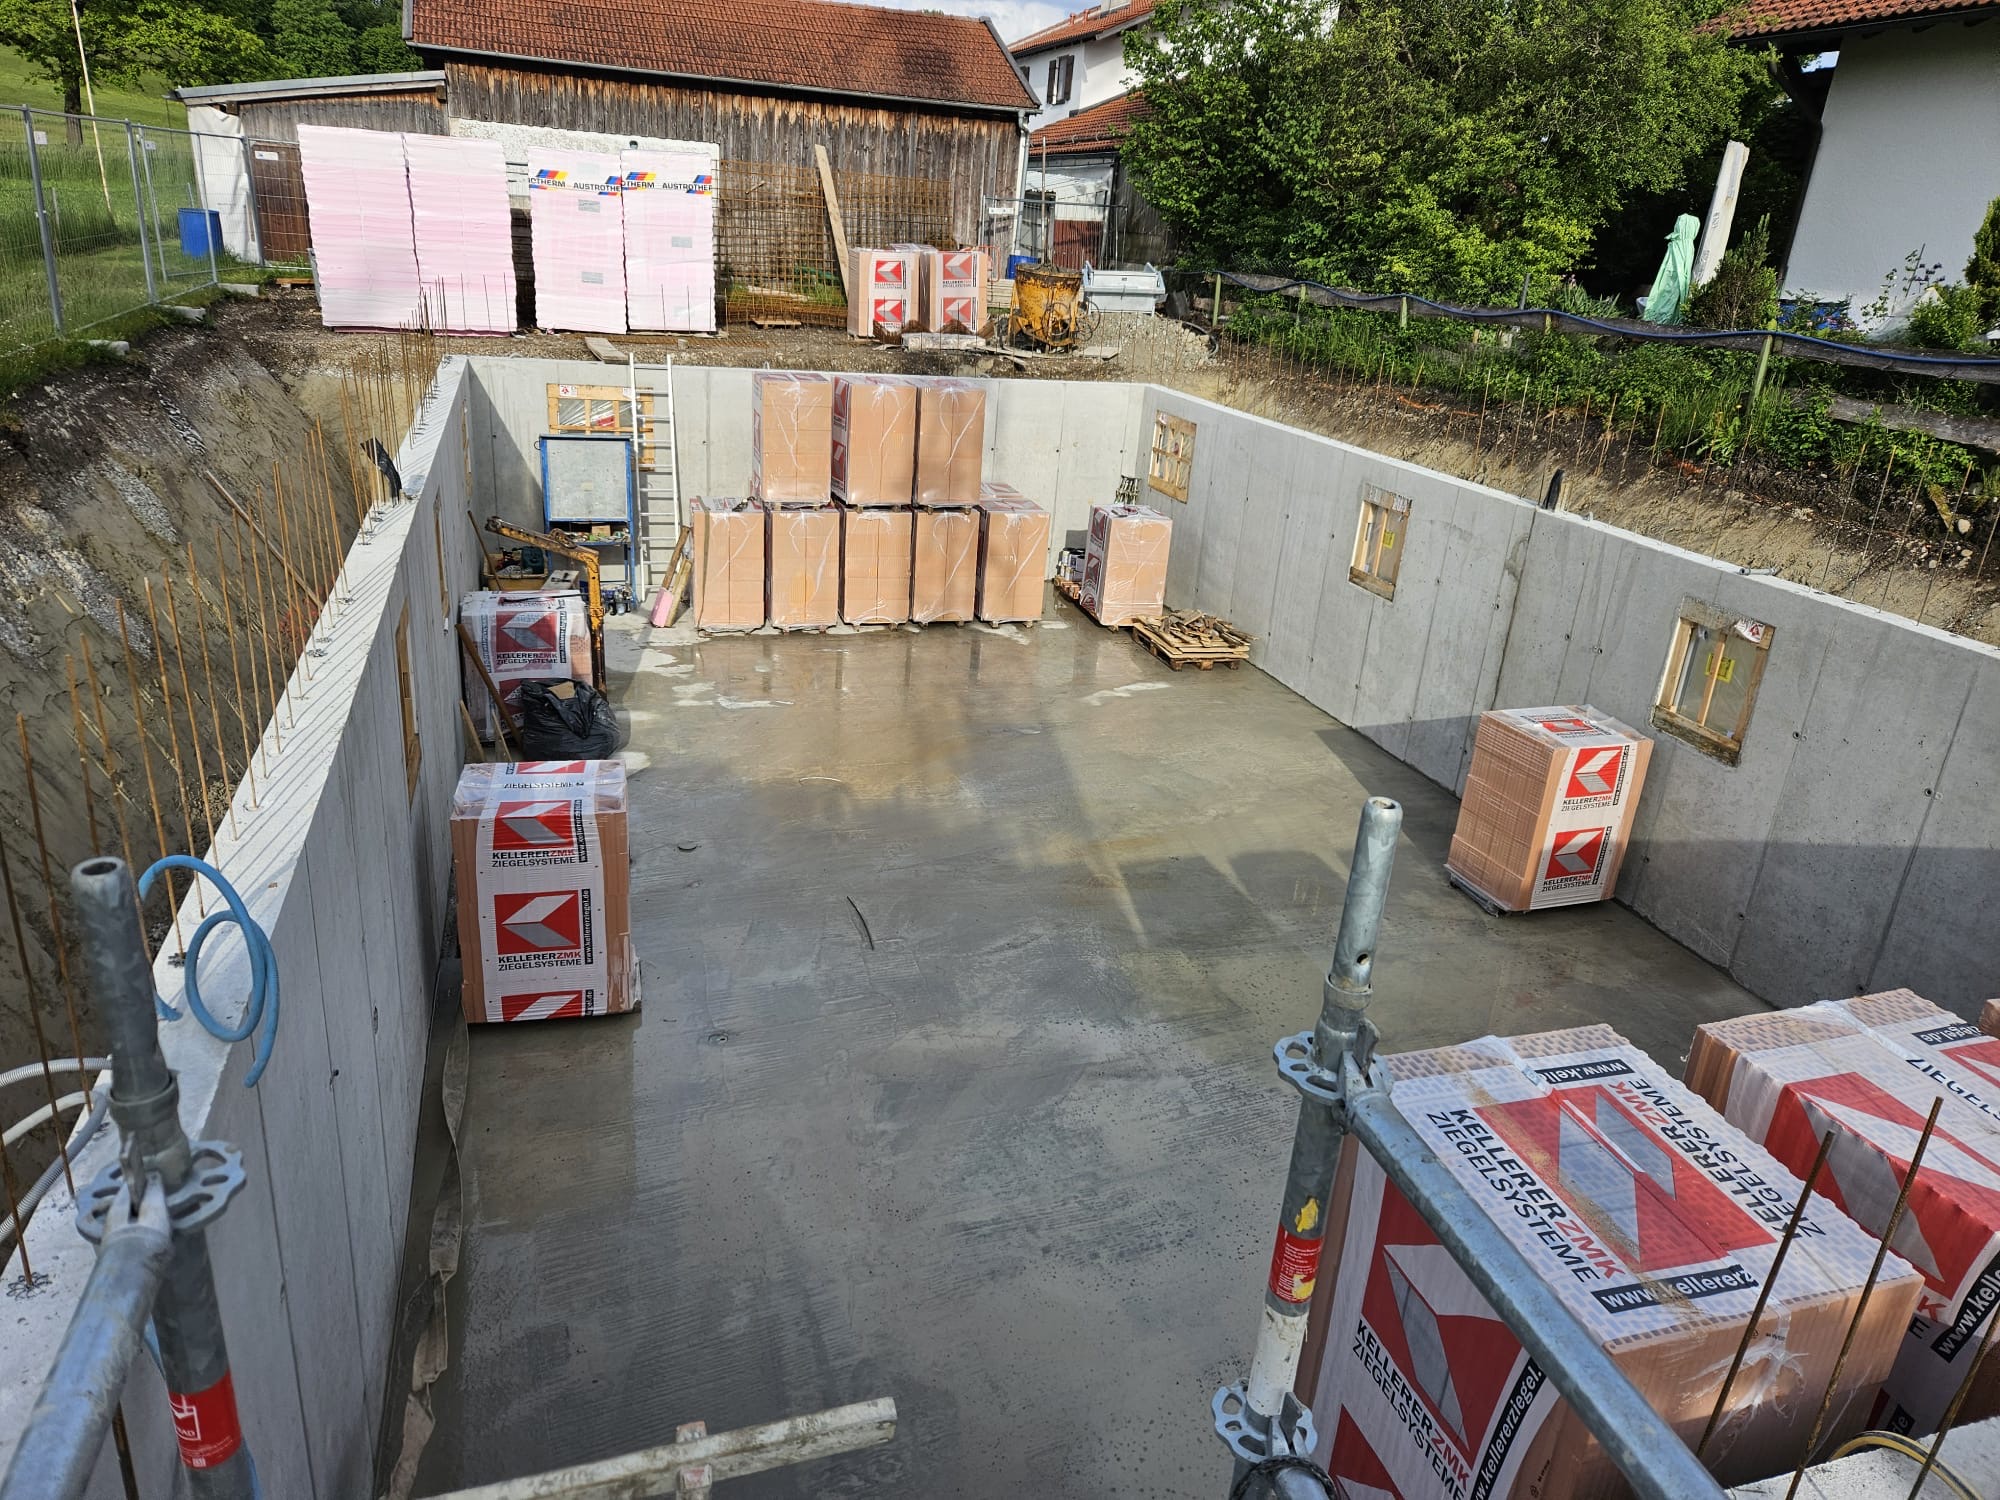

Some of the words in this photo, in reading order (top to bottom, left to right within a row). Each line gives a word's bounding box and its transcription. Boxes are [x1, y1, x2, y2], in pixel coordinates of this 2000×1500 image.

[492, 849, 576, 860] KELLERERZMK
[491, 856, 576, 868] ZIEGELSYSTEME
[498, 951, 582, 964] KELLERERZMK
[498, 958, 582, 972] ZIEGELSYSTEME
[1426, 1111, 1601, 1283] ZIEGELSYSTEME
[1448, 1109, 1626, 1280] KELLERERZMK
[1357, 1319, 1470, 1491] KELLERERZMK
